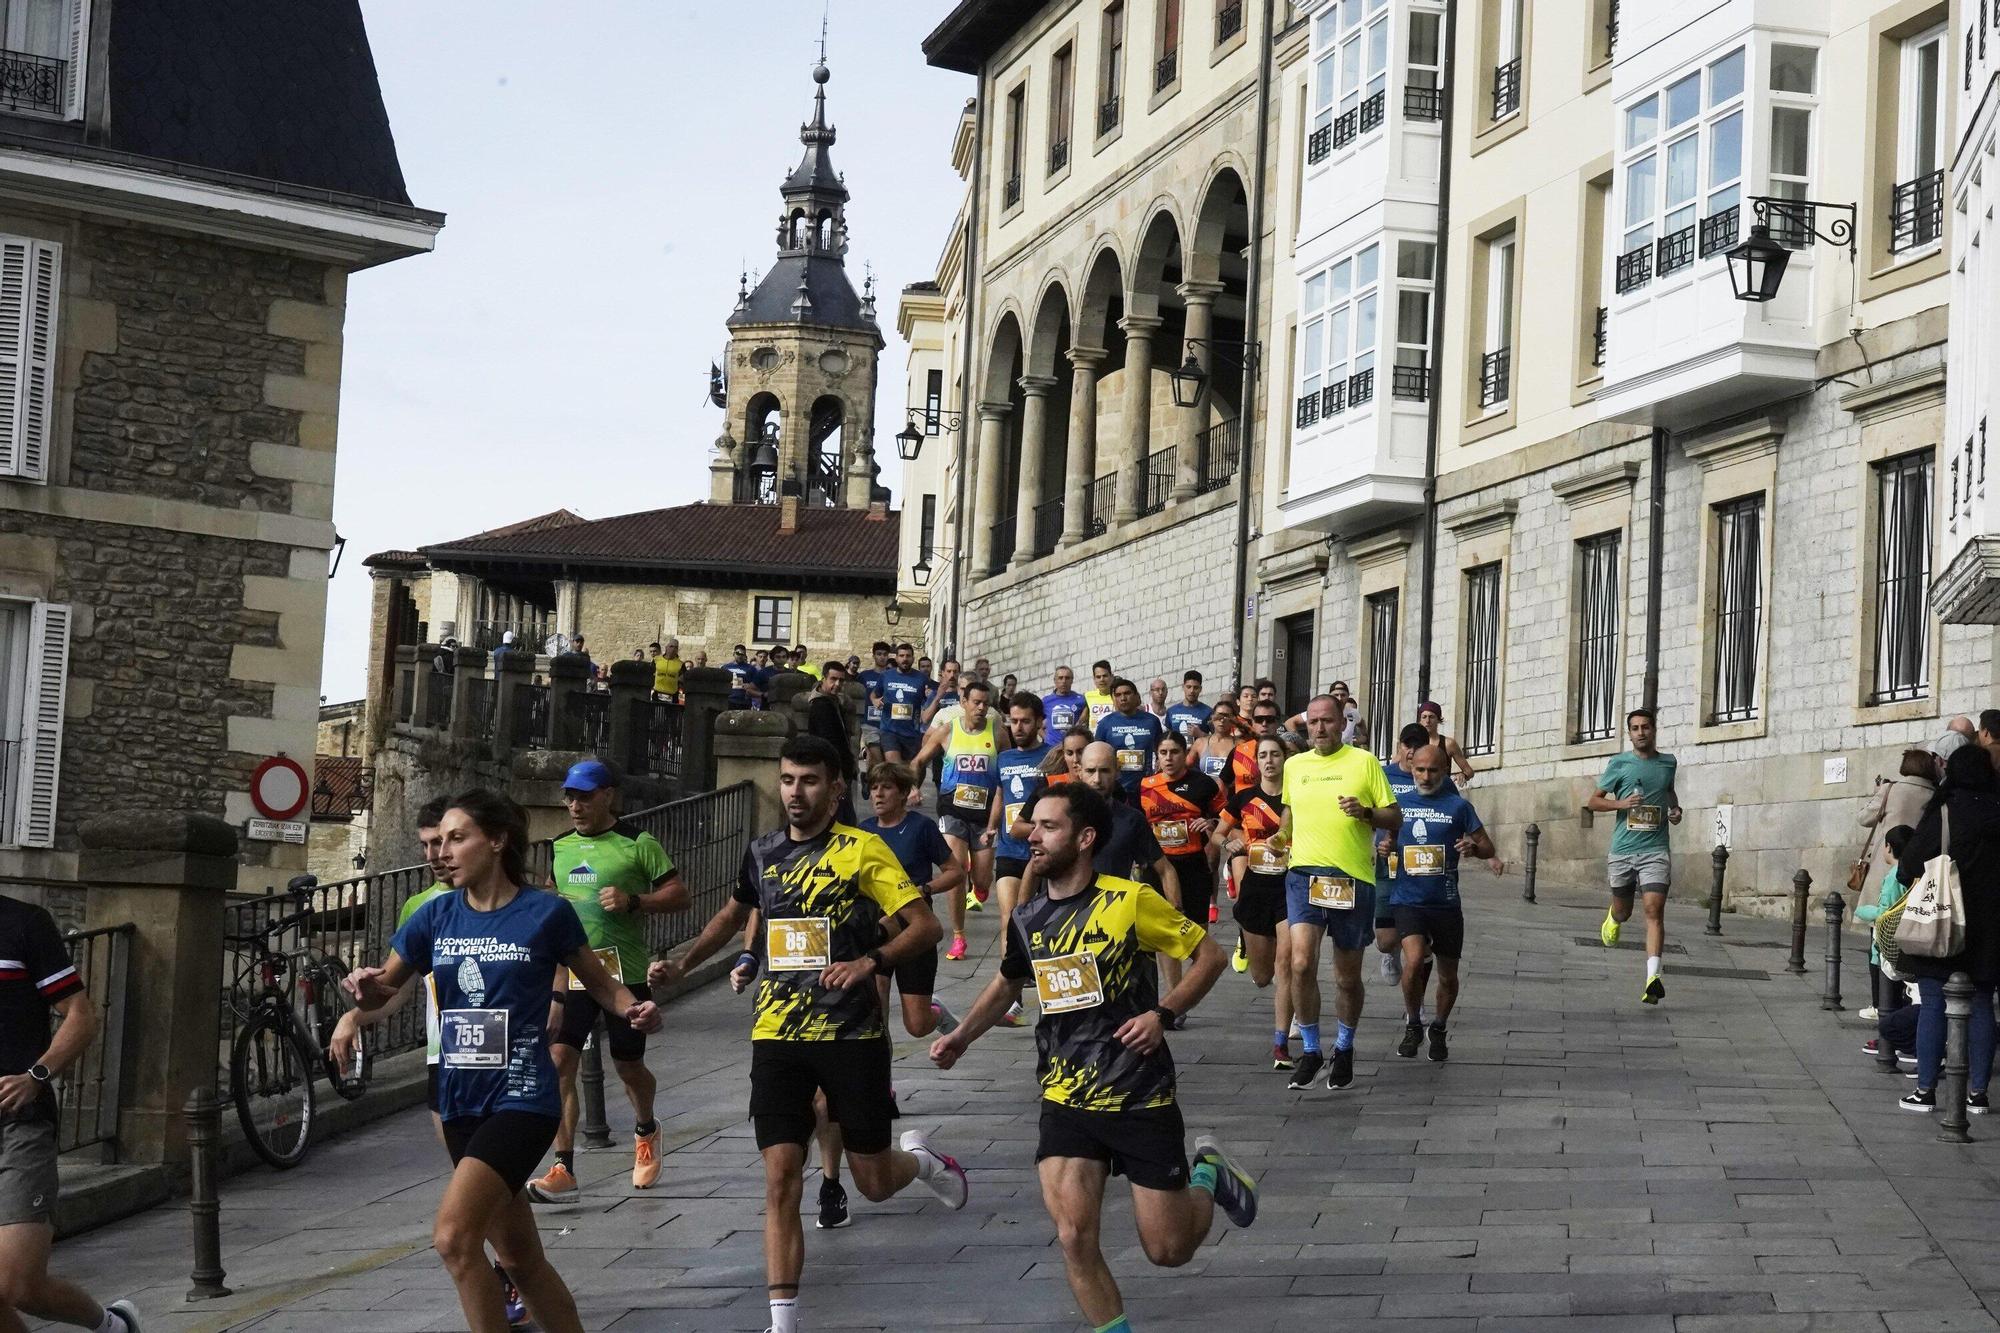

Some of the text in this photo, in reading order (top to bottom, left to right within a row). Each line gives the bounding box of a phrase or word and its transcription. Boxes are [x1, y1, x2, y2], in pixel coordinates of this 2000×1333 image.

[1124, 755, 1138, 763] 519
[963, 790, 980, 801] 262
[1160, 826, 1178, 837] 646
[1415, 852, 1434, 864] 193
[568, 873, 598, 884] AIZKORRI
[1322, 884, 1342, 898] 377
[442, 937, 498, 947] CONQUISTA
[785, 931, 807, 952] 85
[441, 943, 518, 956] ALMENDRA
[480, 953, 531, 963] KONKISTA
[1046, 967, 1082, 993] 363
[454, 1024, 485, 1046] 755
